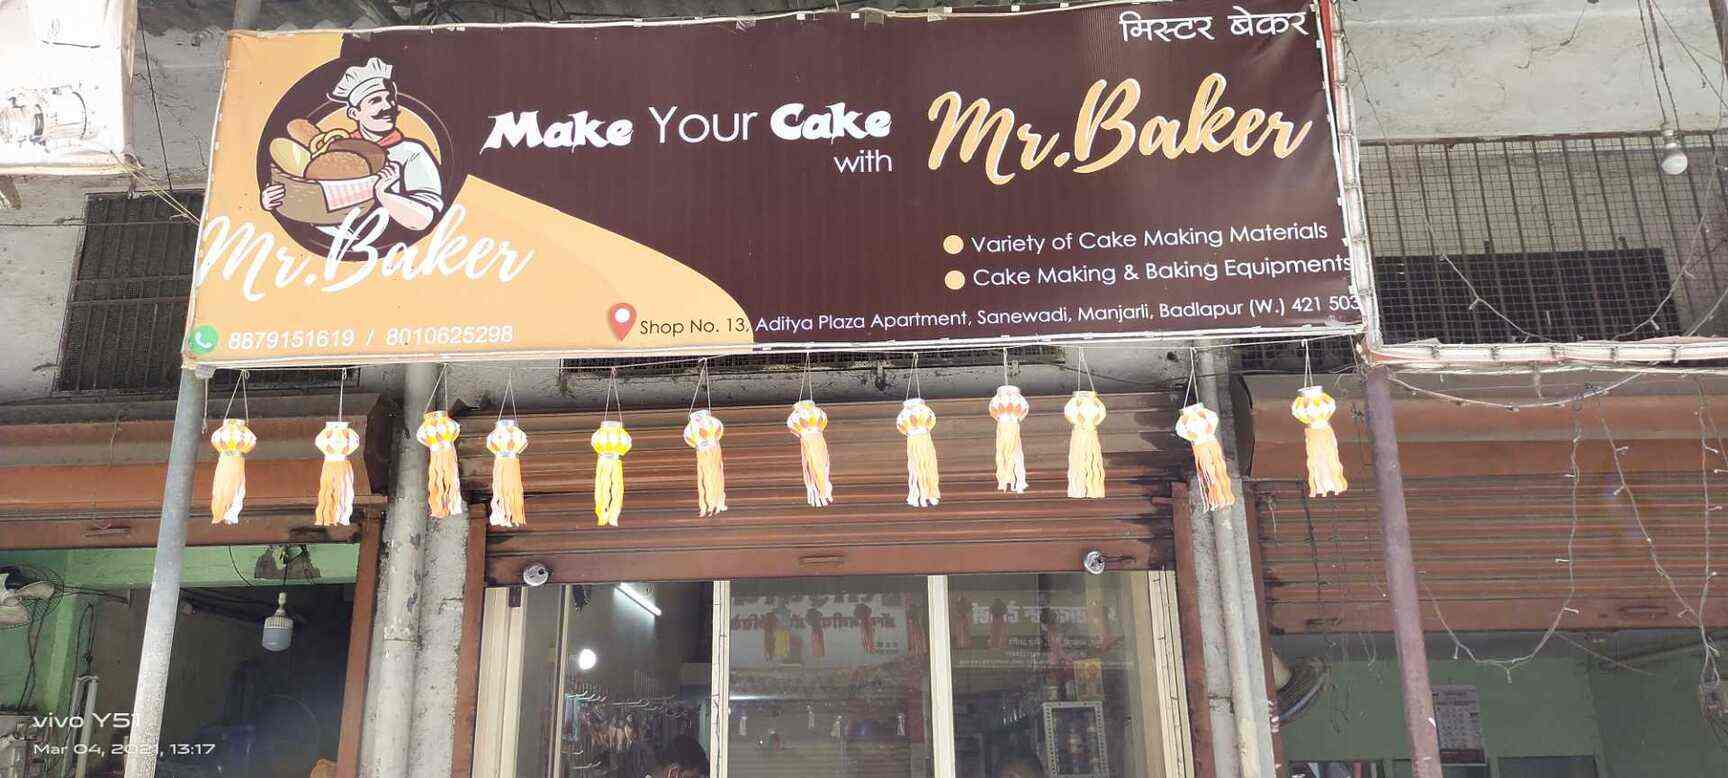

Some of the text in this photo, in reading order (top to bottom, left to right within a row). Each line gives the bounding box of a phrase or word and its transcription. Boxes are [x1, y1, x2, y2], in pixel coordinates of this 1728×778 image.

[1119, 5, 1310, 42] मिस्टर बेकर
[480, 102, 893, 155] Make Your Cake
[833, 149, 893, 174] with
[971, 222, 1328, 255] Variety of Cake Making Materials
[972, 253, 1352, 287] Cake Making & Baking Equipments
[640, 319, 685, 338] Shop
[689, 318, 720, 334] No.
[725, 317, 751, 333] 13,
[755, 315, 814, 334] Aditya
[818, 313, 866, 330] Plaza
[870, 310, 974, 330] Apartment,
[976, 307, 1073, 325] Sanewadi,
[1159, 300, 1244, 321] Badlapur
[1248, 298, 1286, 316] (W.)
[1291, 298, 1324, 313] 421
[1328, 295, 1362, 311] 503
[227, 329, 356, 350] 8879151619
[386, 325, 513, 347] 8010625298
